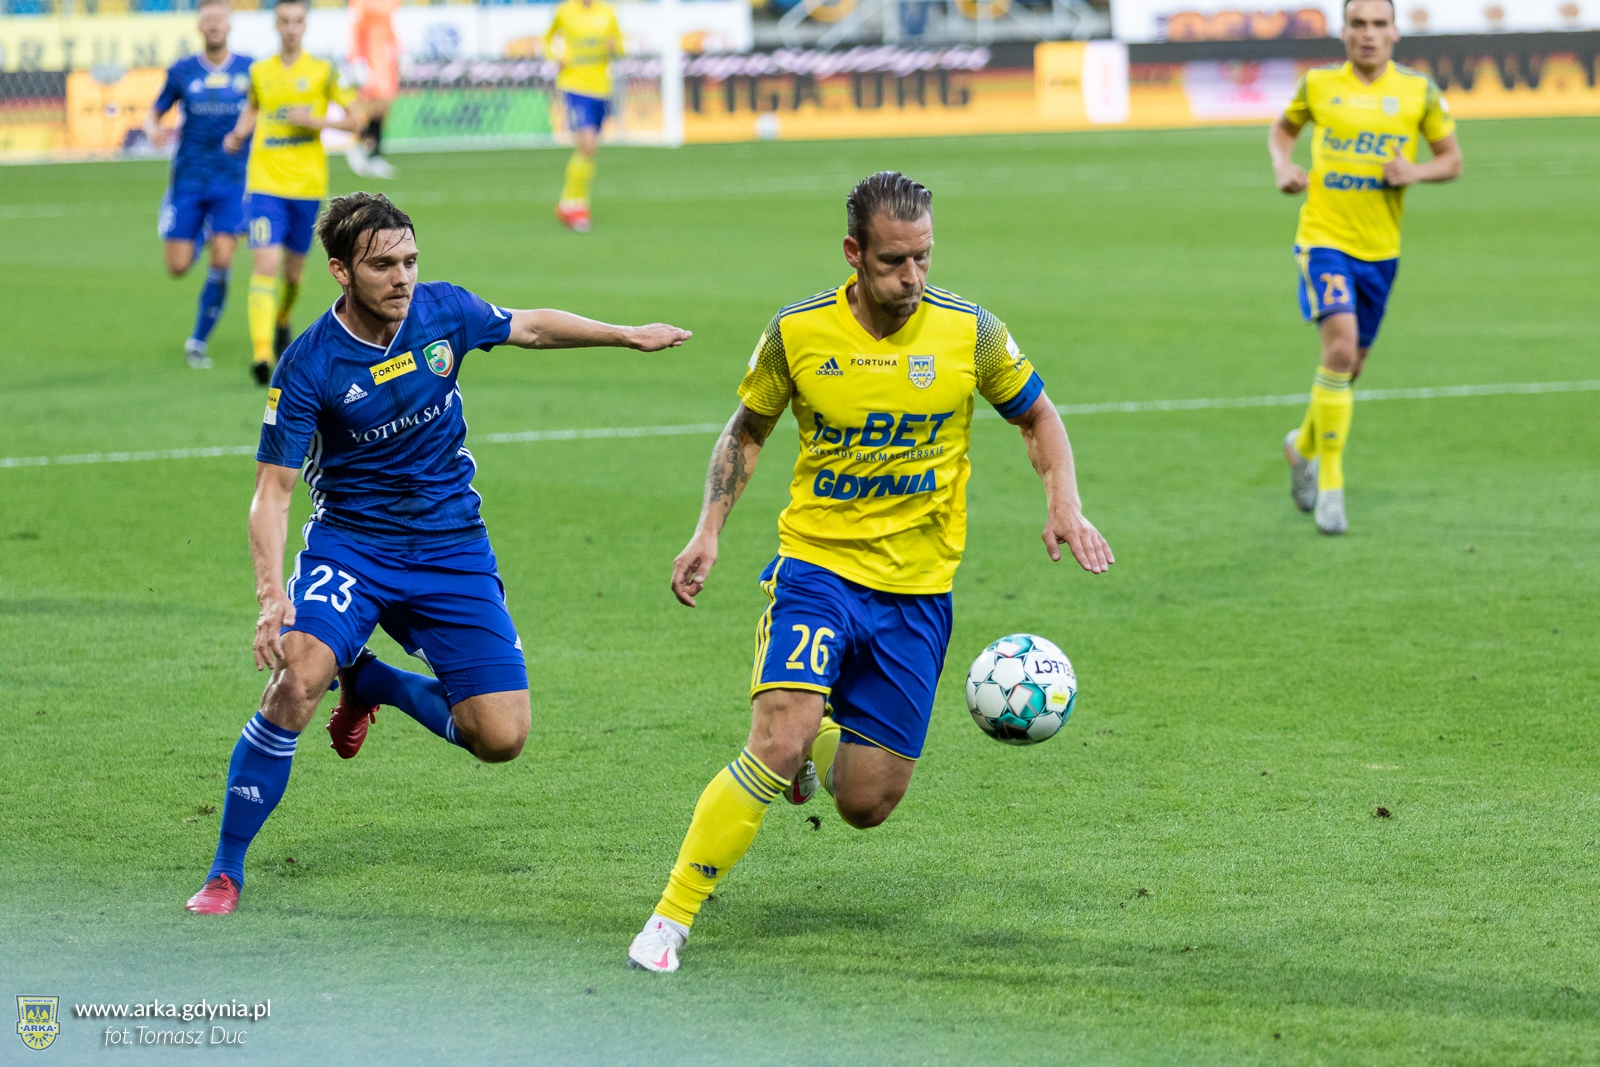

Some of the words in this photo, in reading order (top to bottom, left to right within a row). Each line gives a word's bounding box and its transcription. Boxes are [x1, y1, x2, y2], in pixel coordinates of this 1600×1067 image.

[372, 357, 414, 380] FORTUNA
[850, 358, 898, 367] FORTUNA
[343, 391, 368, 403] adidas
[423, 404, 441, 423] SA
[812, 410, 955, 447] forBET
[813, 468, 937, 501] GDYNIA
[303, 564, 357, 613] 23
[785, 624, 835, 676] 26
